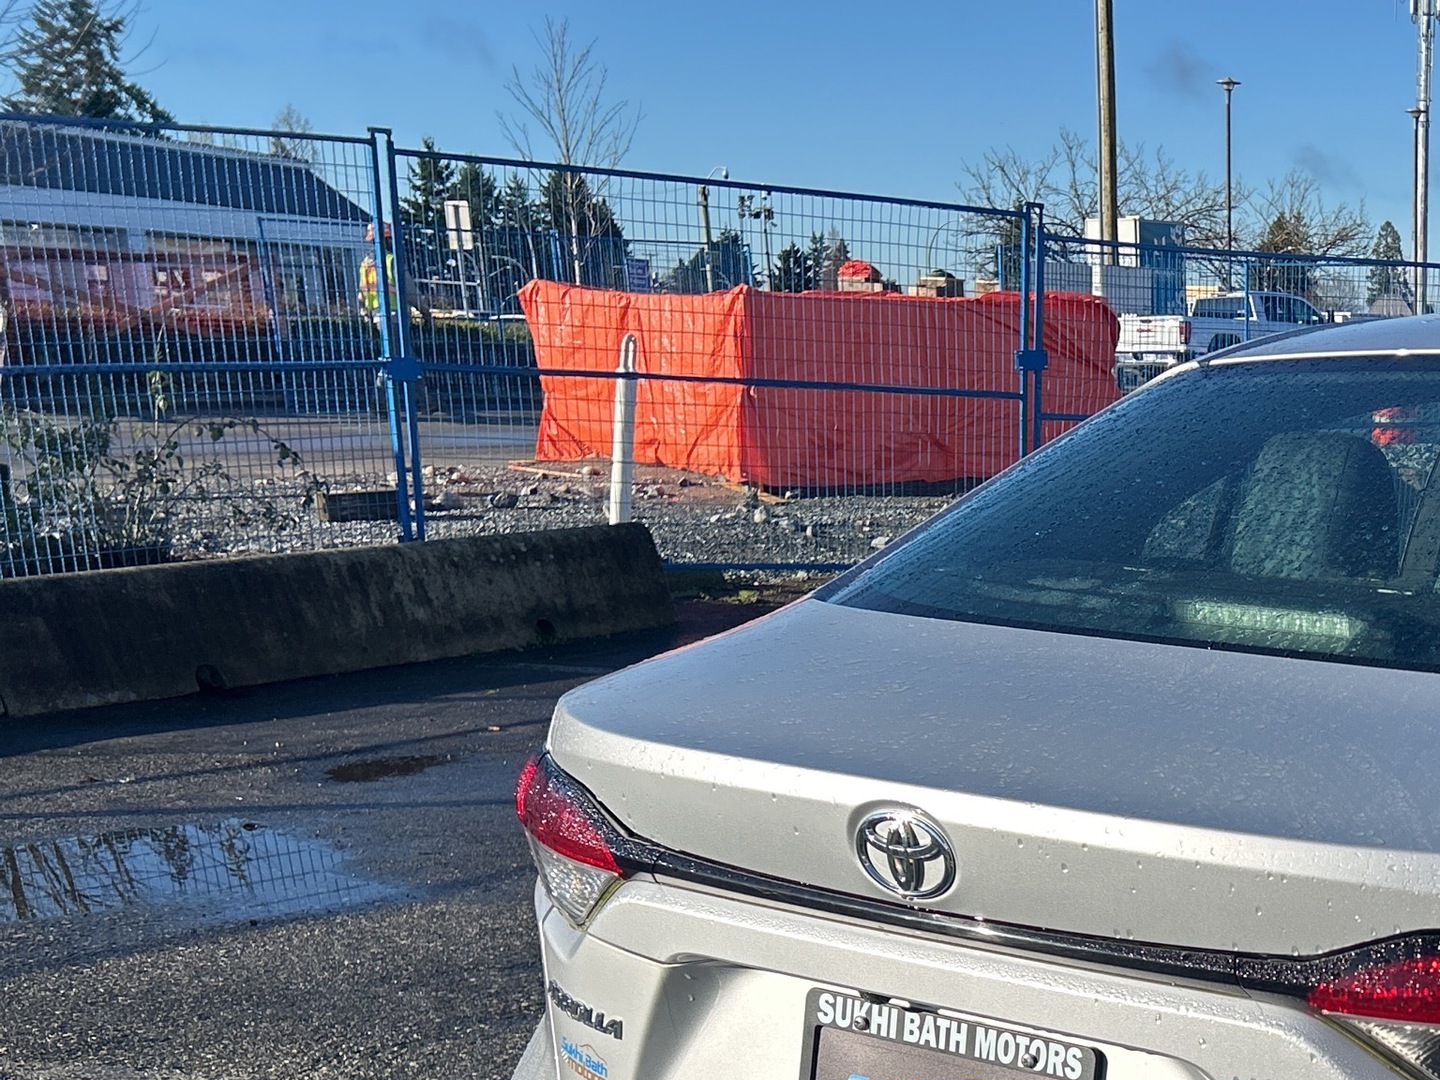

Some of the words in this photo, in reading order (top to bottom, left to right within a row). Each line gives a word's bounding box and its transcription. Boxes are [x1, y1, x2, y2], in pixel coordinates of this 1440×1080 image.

[561, 1035, 584, 1062] Sukhi
[585, 1052, 608, 1078] Bath
[816, 993, 899, 1040] SUKHI
[903, 1012, 968, 1055] BATH
[974, 1029, 1083, 1080] MOTORS
